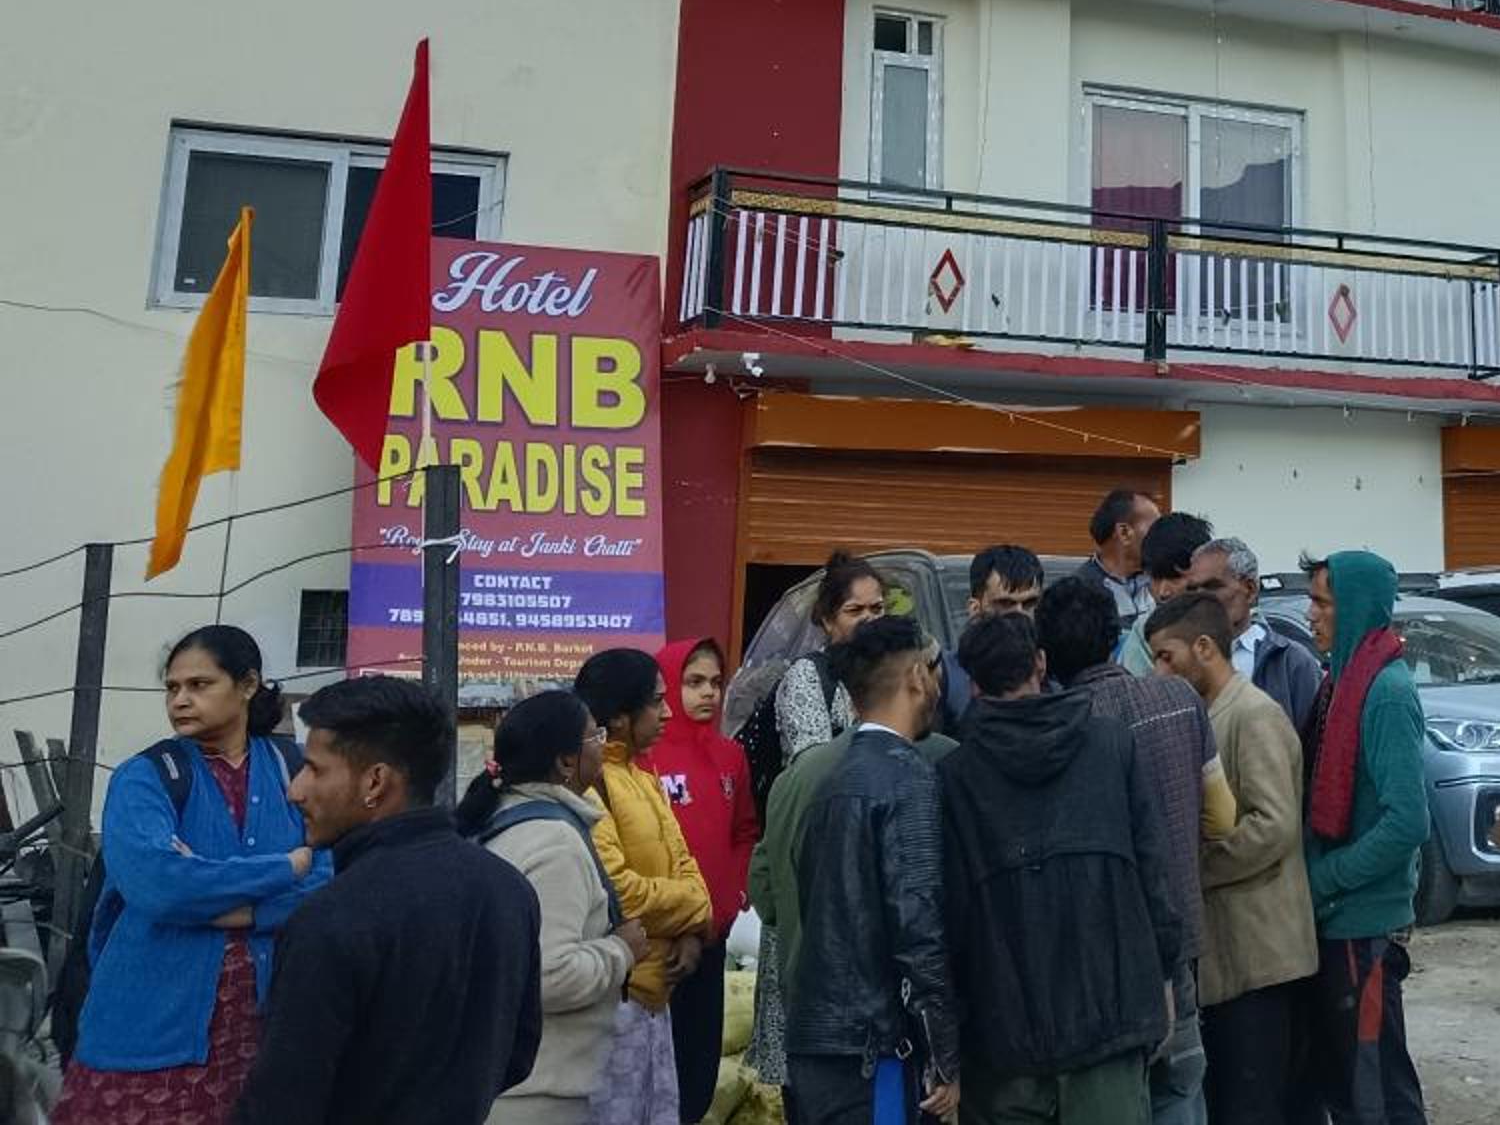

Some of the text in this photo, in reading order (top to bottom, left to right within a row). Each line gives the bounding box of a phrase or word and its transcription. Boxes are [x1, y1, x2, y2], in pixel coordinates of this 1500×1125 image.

[431, 250, 598, 318] Hotel
[390, 326, 647, 429] RNB
[376, 432, 647, 517] PARADISE
[497, 535, 519, 553] at
[520, 532, 577, 559] Janki
[473, 574, 553, 590] CONTACT
[502, 656, 552, 668] Tourism
